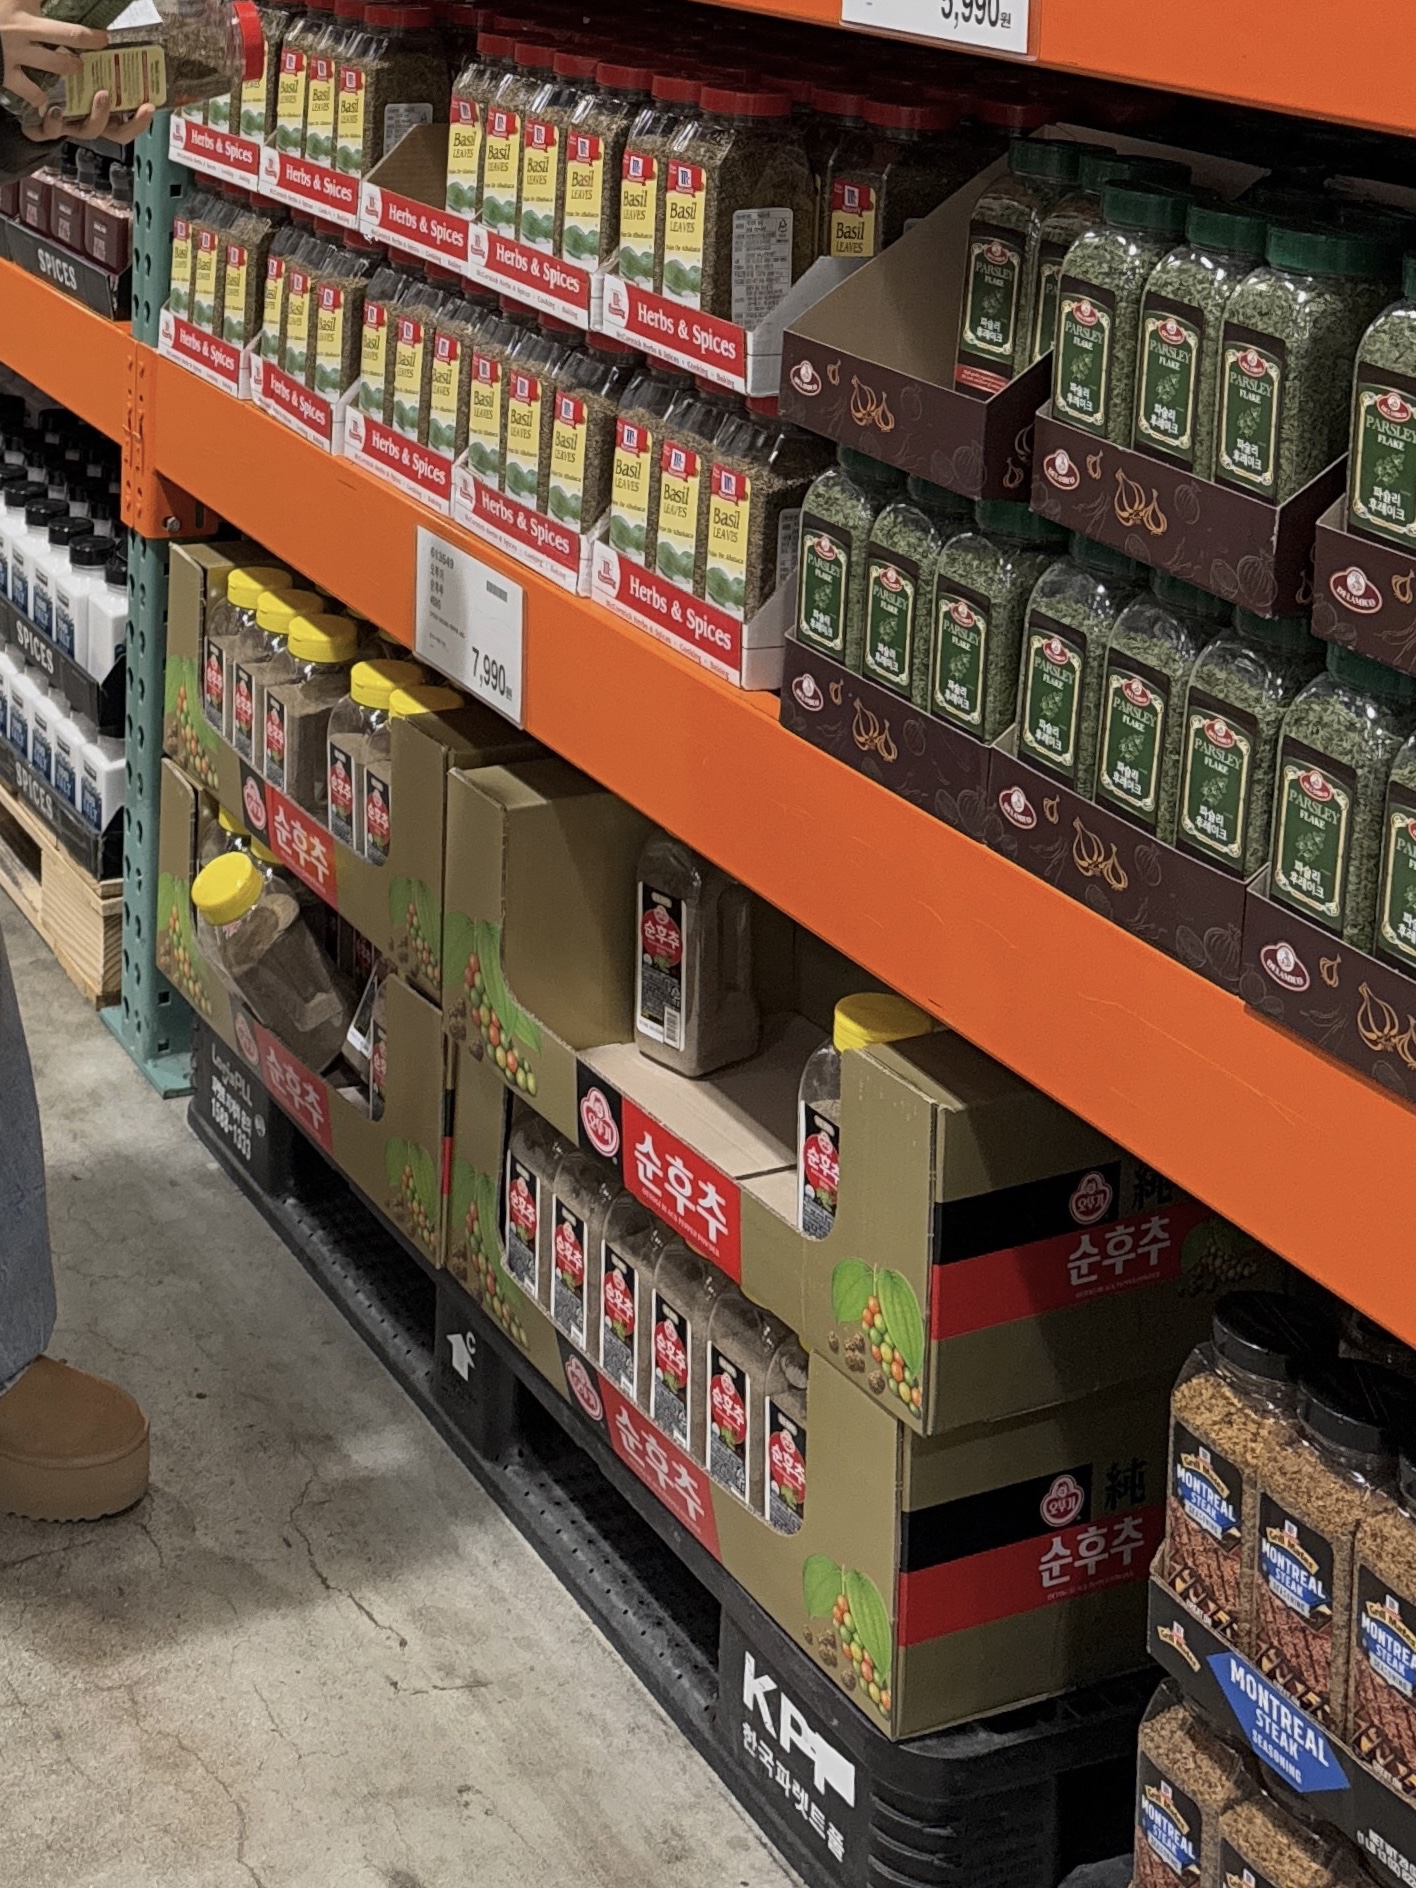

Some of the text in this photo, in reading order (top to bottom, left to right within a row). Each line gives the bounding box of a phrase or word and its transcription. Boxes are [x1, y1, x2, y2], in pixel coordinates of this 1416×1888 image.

[572, 170, 594, 189] Basil
[623, 189, 648, 208] Basil
[669, 201, 697, 220] Basil
[623, 206, 646, 221] LEAVES
[669, 218, 695, 233] LEAVES
[835, 220, 866, 243] Basil
[835, 238, 863, 255] LEAVES
[37, 247, 78, 292] SPICES
[495, 243, 580, 294] Herbs & Spices
[637, 302, 736, 360] Herbs & Spices
[1065, 321, 1103, 347] PARSLEY
[1149, 338, 1192, 365] PARSLEY
[1229, 370, 1273, 398] PARSLEY
[1239, 388, 1262, 405] FLAKE
[555, 431, 578, 451] Basil
[1235, 438, 1259, 456] 파슬리
[1377, 432, 1405, 452] FLAKE
[615, 458, 641, 479] Basil
[663, 483, 690, 506] Basil
[1372, 485, 1402, 505] 파슬리
[481, 487, 570, 555] Herbs & Spices
[713, 508, 740, 530] Basil
[712, 527, 739, 544] LEAVES
[1336, 584, 1380, 608] DELAMICO
[628, 574, 732, 652] Herbs & Spices
[15, 619, 54, 675] SPICES
[943, 620, 982, 646] PARSLEY
[1034, 656, 1075, 685] PARSLEY
[1113, 696, 1158, 726] PARSLEY
[1121, 715, 1146, 733] FLAKE
[1194, 736, 1242, 770] PARSLEY
[1203, 757, 1229, 776] FLAKE
[1116, 760, 1140, 780] 파슬리
[14, 760, 55, 823] SPICES
[1199, 804, 1224, 825] 파슬리
[1287, 790, 1339, 826] PARSLEY
[273, 794, 331, 885] 순후추
[1293, 860, 1321, 883] 파슬리
[643, 919, 680, 951] 순후추
[1266, 959, 1304, 987] DELAMICO
[265, 1044, 324, 1140] 순후추
[634, 1131, 730, 1245] 순후추
[1066, 1216, 1171, 1286] 순후추
[712, 1384, 745, 1432] 순후추
[615, 1406, 706, 1525] 순후추
[1049, 1493, 1077, 1514] 오뚜기
[1176, 1463, 1237, 1523] MONTREAL
[1190, 1487, 1218, 1521] STEAK
[1038, 1516, 1145, 1589] 순후추
[1261, 1537, 1327, 1600] MONTREAL
[1275, 1568, 1304, 1598] STEAK
[1230, 1657, 1330, 1769] MONTREAL
[1255, 1707, 1300, 1759] STEAK
[1251, 1730, 1302, 1786] SEASONING
[741, 1721, 846, 1864] 한국파렛트풀
[1141, 1798, 1196, 1859] MONTREAL
[1151, 1822, 1178, 1855] STEAK
[1368, 1828, 1384, 1847] NET
[1386, 1842, 1398, 1862] WT
